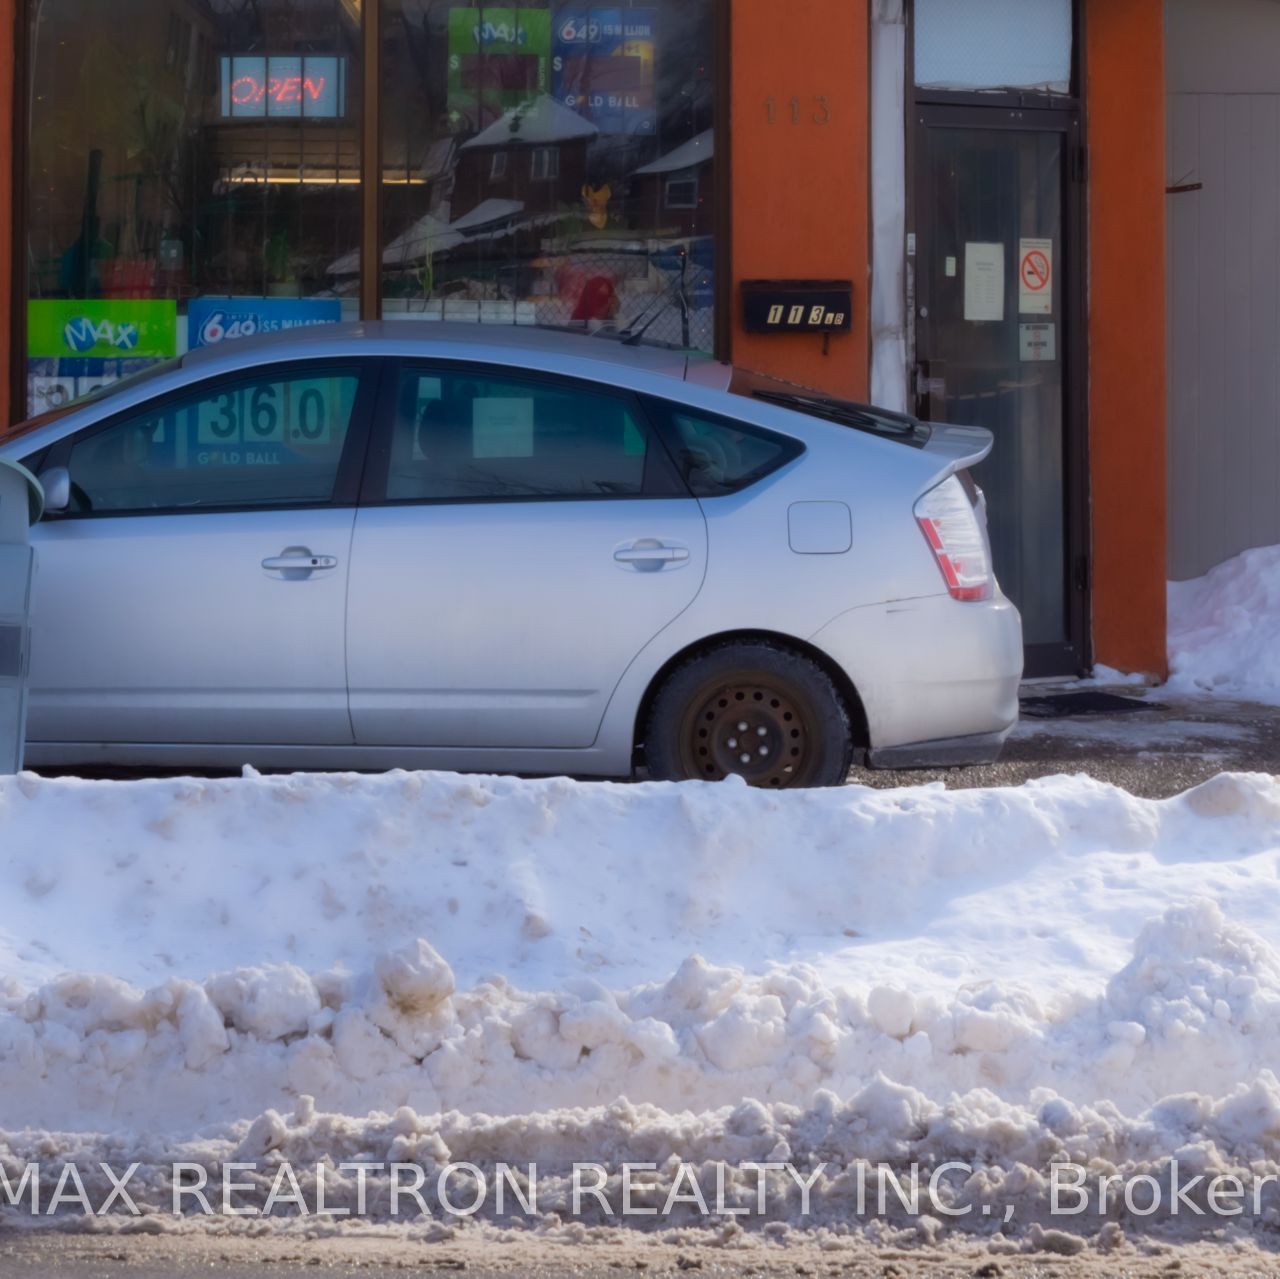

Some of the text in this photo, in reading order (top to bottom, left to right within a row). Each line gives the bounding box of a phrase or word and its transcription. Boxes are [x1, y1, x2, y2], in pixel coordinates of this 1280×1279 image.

[231, 75, 325, 103] OPEN
[762, 95, 831, 126] 113
[64, 317, 135, 352] MAX
